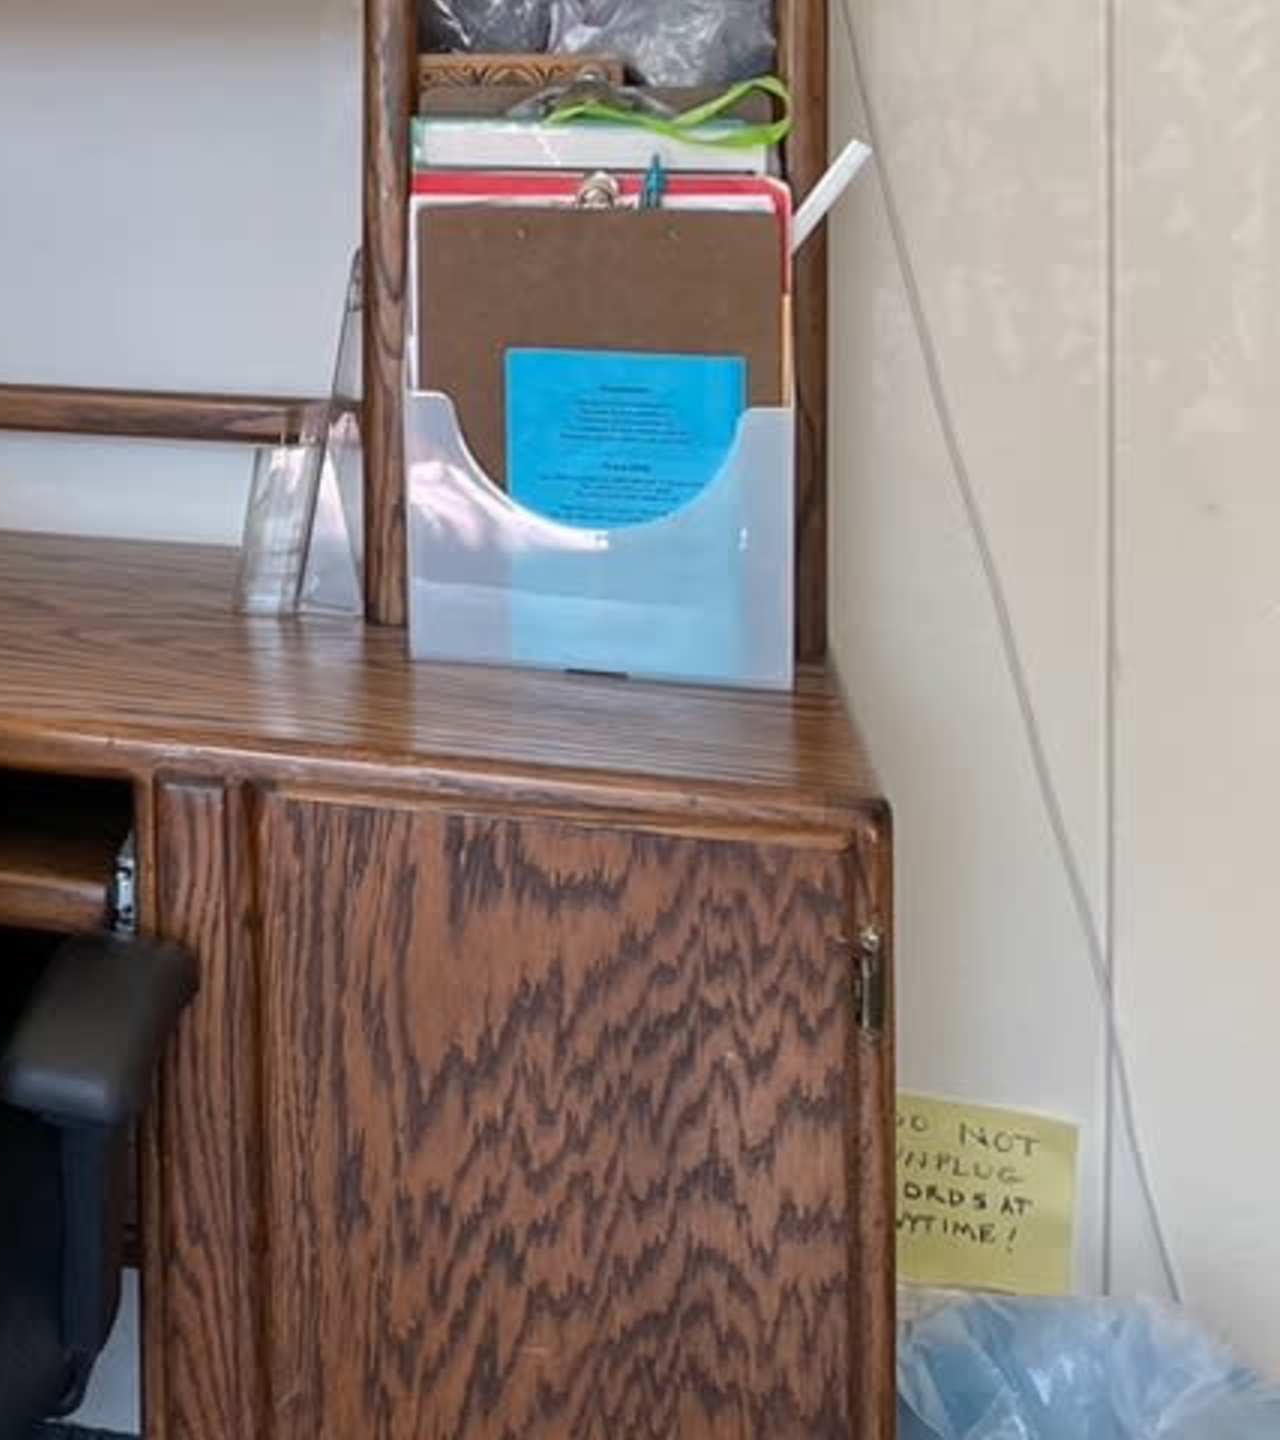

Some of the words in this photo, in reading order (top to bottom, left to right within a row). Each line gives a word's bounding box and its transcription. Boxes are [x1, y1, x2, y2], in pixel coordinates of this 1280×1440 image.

[958, 1122, 1041, 1157] NOT
[896, 1149, 1024, 1185] NPLUG
[903, 1181, 987, 1211] ORDS
[1000, 1196, 1035, 1216] AT
[896, 1210, 1017, 1253] NYTIME!
